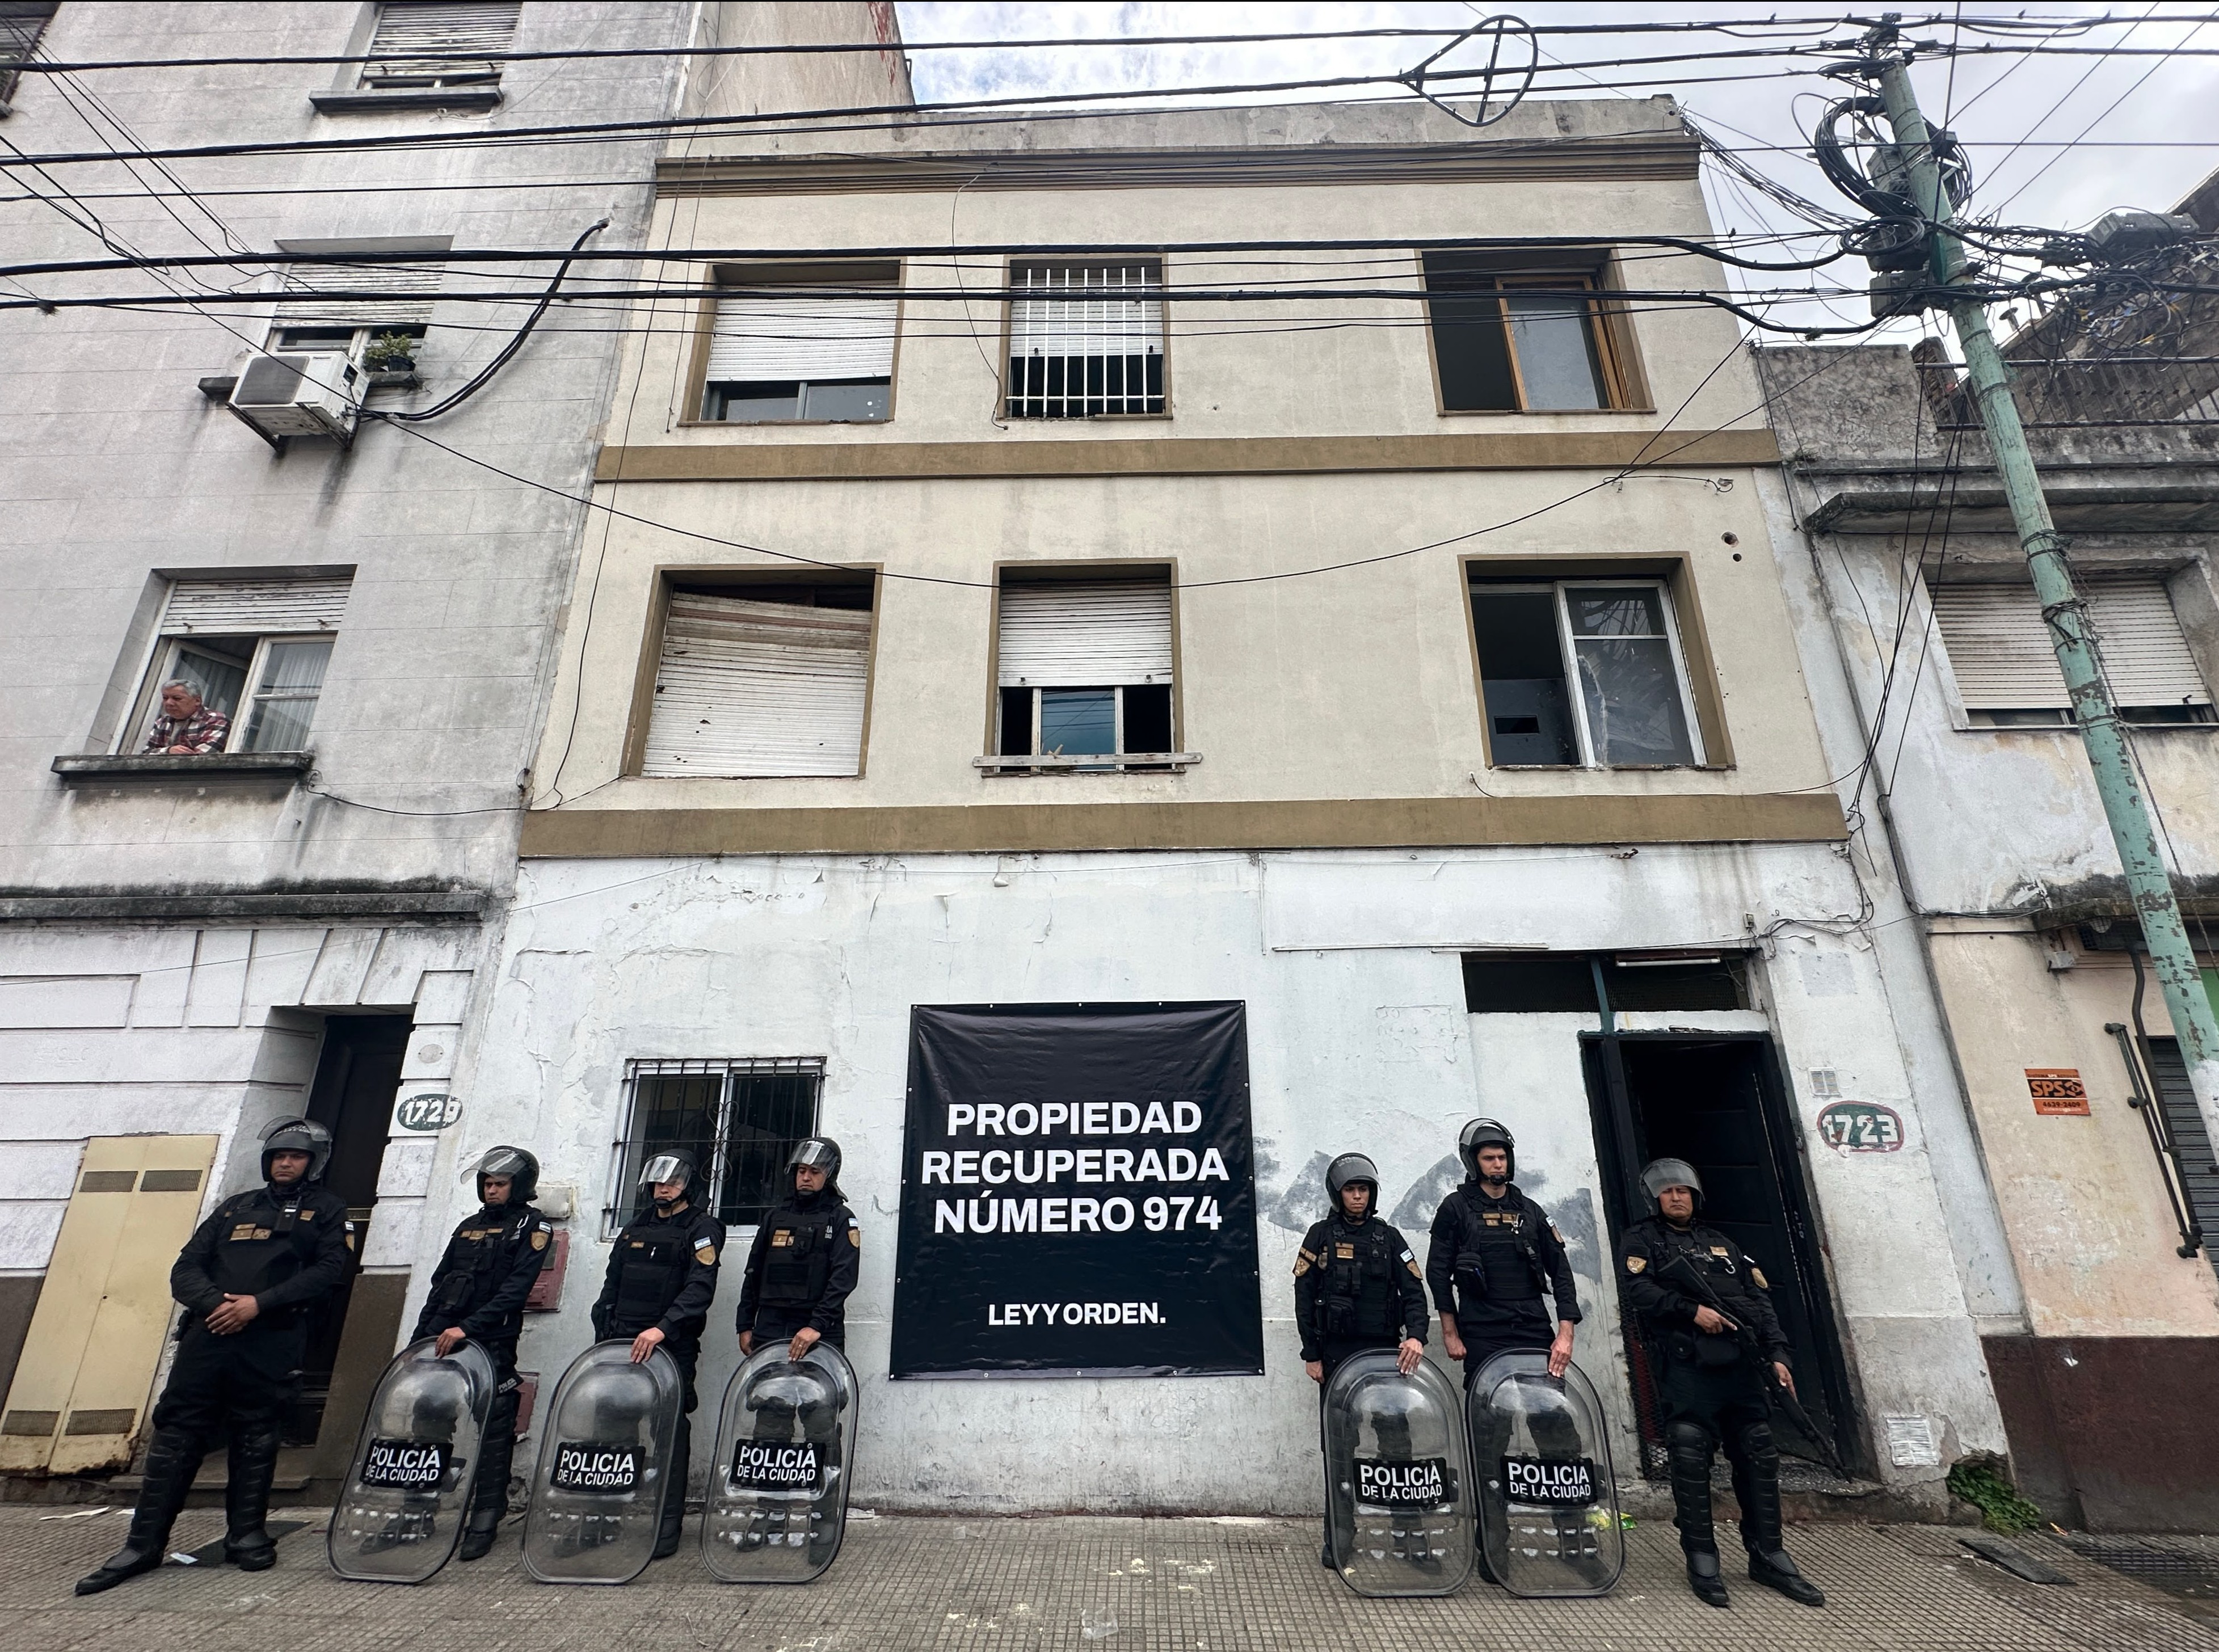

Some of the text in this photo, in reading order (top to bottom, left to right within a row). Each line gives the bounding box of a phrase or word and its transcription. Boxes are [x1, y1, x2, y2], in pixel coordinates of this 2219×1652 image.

[2031, 1080, 2066, 1097] SPS
[947, 1101, 1202, 1136] PROPIEDAD
[1821, 1114, 1898, 1143] 1723
[921, 1147, 1230, 1185] RECUPERADA
[934, 1190, 1223, 1233] NÚMERO 974
[988, 1302, 1167, 1325] LEY Y ORDEN.
[369, 1446, 441, 1469] POLICIA
[560, 1449, 635, 1473] POLICIA
[739, 1446, 816, 1468] POLICIA
[365, 1464, 439, 1482] DE LA CIUDAD
[557, 1468, 634, 1486] DE LA CIUDAD
[737, 1465, 816, 1481] DE LA CIUDAD
[1360, 1464, 1442, 1487] POLICIA
[1508, 1462, 1589, 1485] POLICIA
[1362, 1484, 1443, 1500] DE LA CIUDAD
[1509, 1481, 1591, 1498] DE LA CIUDAD
